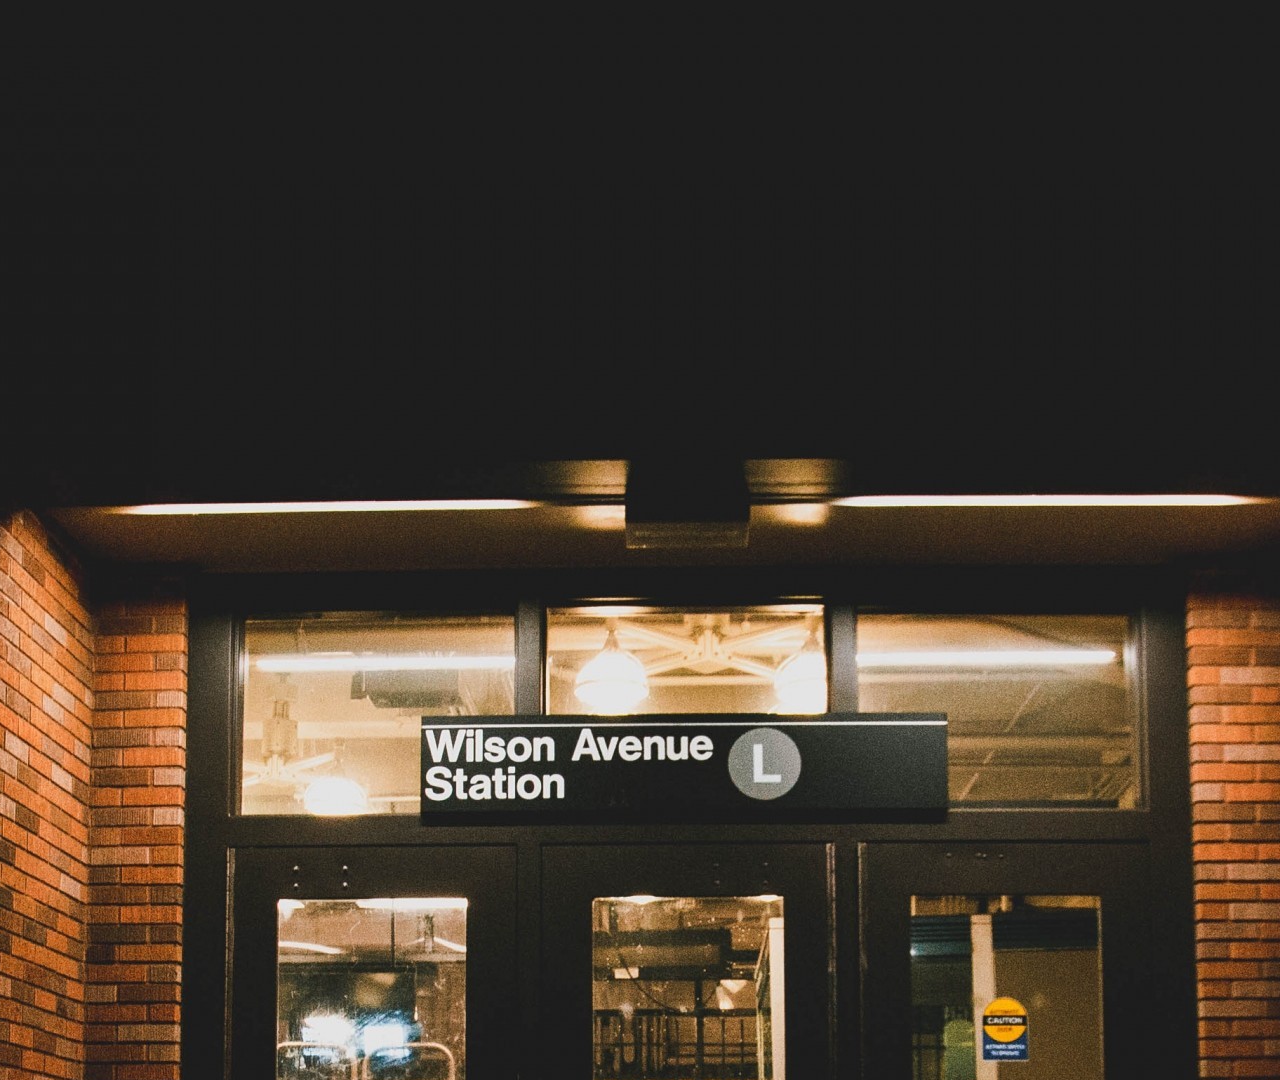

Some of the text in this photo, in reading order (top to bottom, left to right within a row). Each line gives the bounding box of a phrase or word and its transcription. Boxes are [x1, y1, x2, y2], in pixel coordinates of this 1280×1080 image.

[424, 729, 714, 763] Wilson Avenue
[752, 743, 782, 784] L
[424, 766, 566, 801] Station
